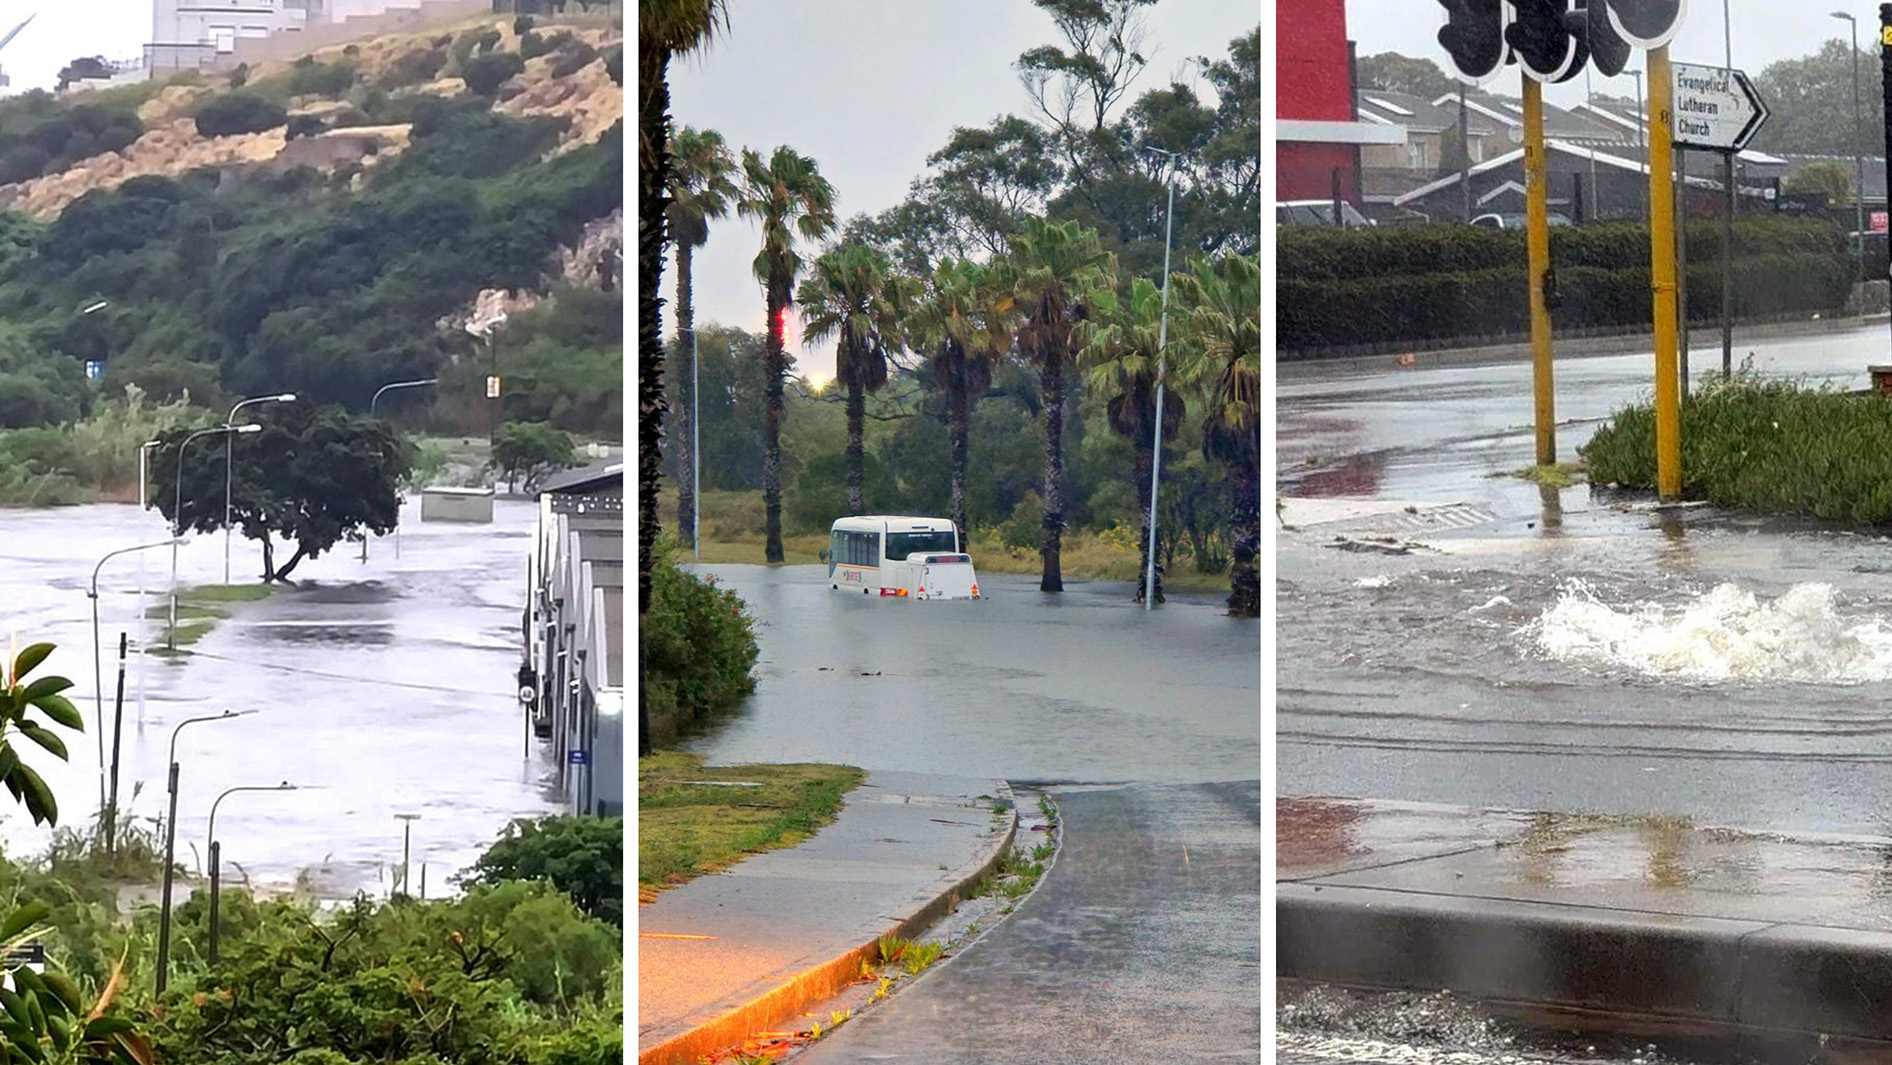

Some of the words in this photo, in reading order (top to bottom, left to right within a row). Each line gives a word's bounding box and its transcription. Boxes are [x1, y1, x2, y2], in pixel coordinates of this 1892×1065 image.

[1678, 73, 1729, 94] Evangelical
[1679, 96, 1718, 114] Lutheran
[1679, 119, 1710, 136] Church
